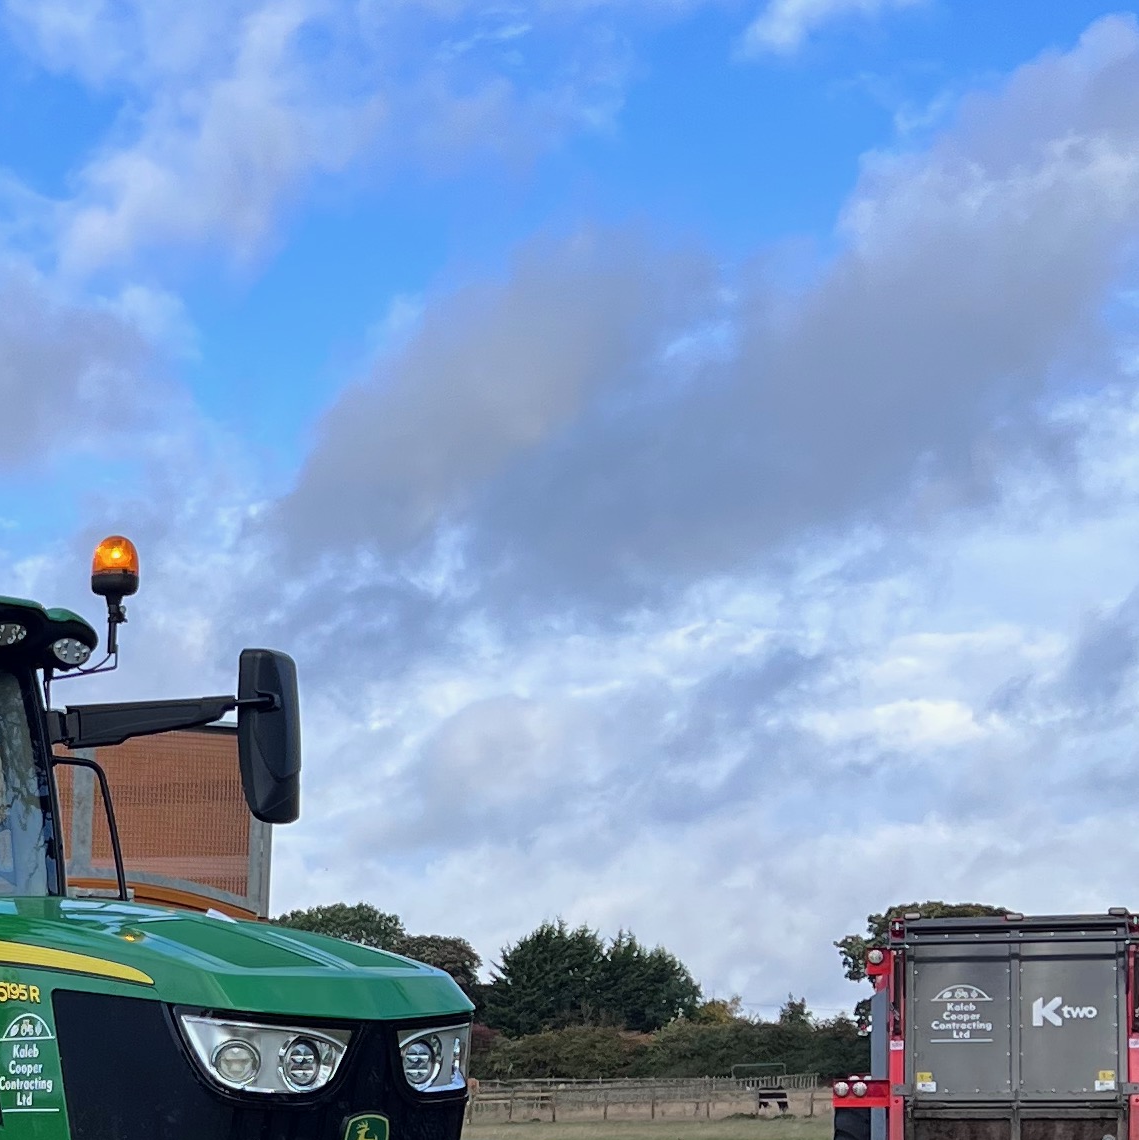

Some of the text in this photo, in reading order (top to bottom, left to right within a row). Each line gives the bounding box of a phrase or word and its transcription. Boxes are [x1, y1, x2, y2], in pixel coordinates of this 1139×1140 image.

[946, 1002, 976, 1012] Kaleb
[942, 1012, 980, 1024] Cooper
[931, 1021, 993, 1032] Contracting
[952, 1030, 971, 1039] Ltd
[12, 1043, 39, 1059] Kaleb
[8, 1060, 43, 1077] Cooper
[0, 1076, 53, 1093] Contracting
[16, 1092, 33, 1107] Ltd
